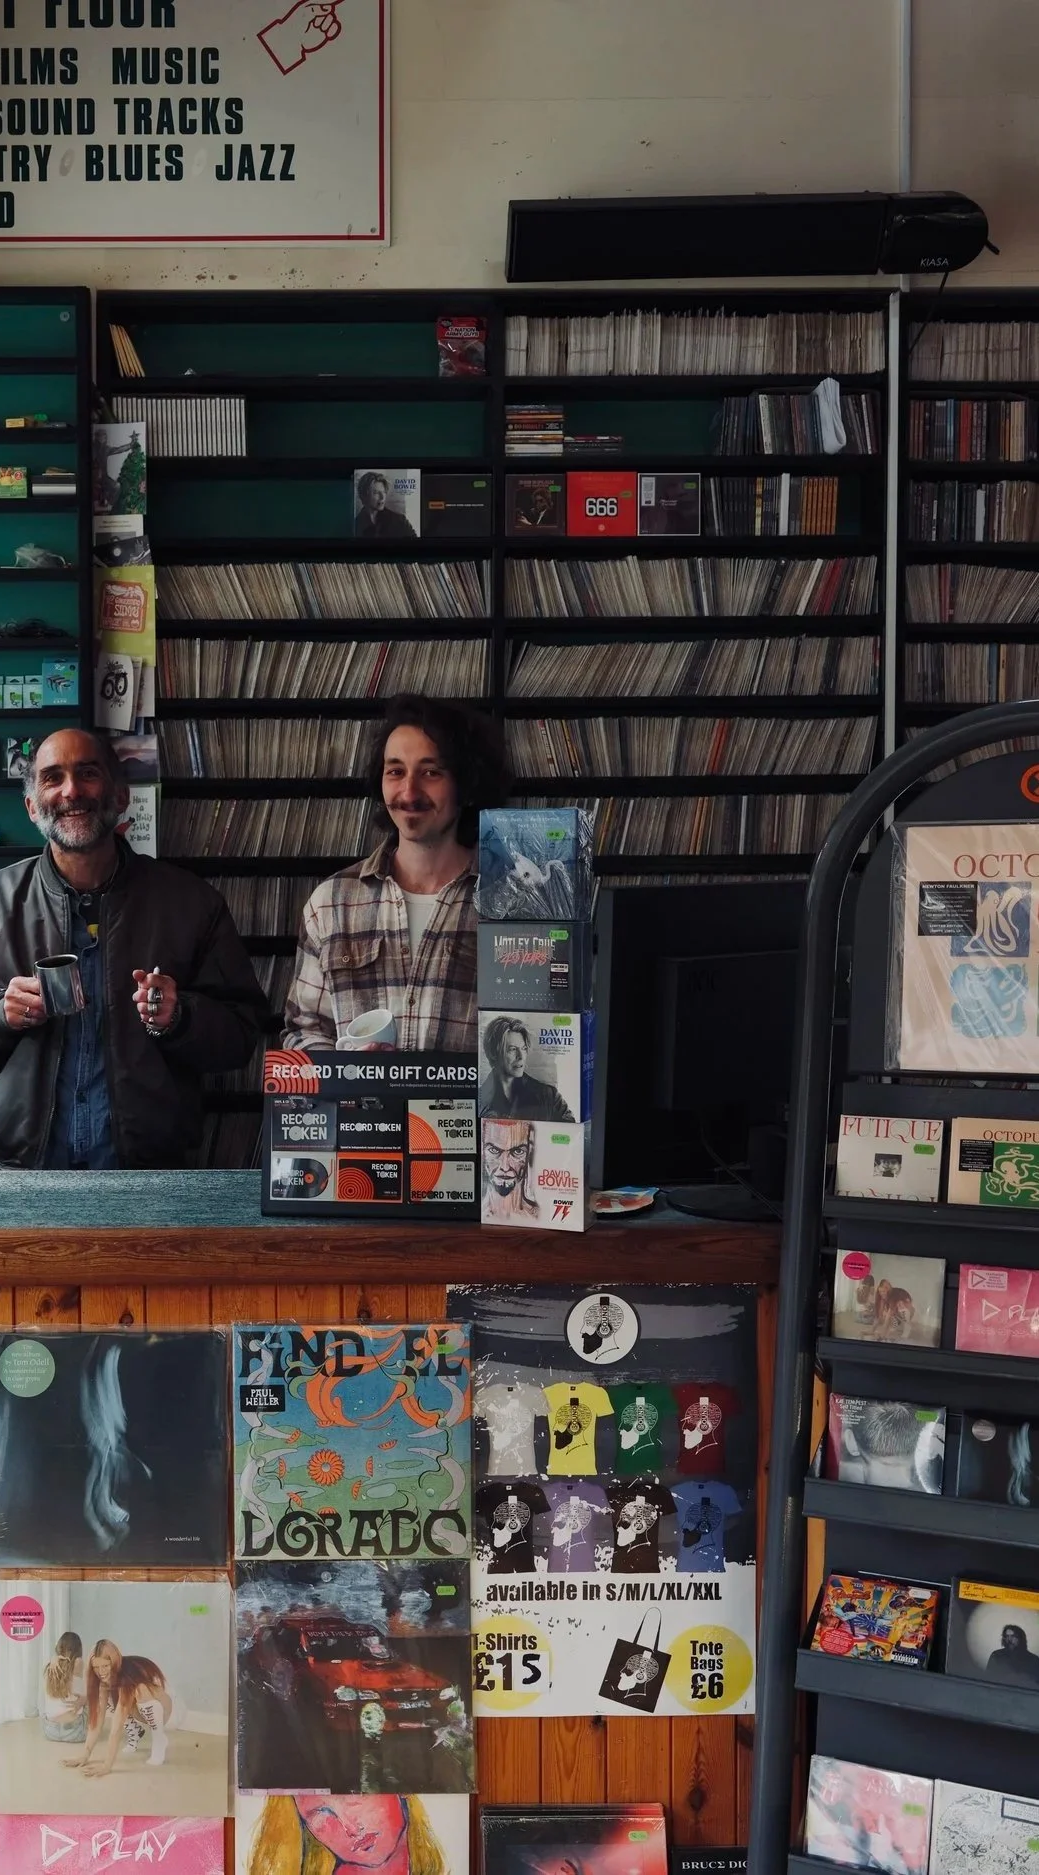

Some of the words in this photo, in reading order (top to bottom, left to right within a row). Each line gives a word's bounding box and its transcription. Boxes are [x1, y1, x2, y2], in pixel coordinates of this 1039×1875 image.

[112, 47, 219, 86] MUSIC
[114, 98, 243, 136] TRACKS
[85, 144, 184, 182] BLUES
[216, 144, 295, 181] JAZZ
[920, 257, 949, 267] KIASA
[585, 498, 618, 516] 666
[540, 1028, 573, 1038] DAVID
[538, 1037, 575, 1046] BOWIE
[272, 1063, 331, 1080] RECORD
[336, 1064, 385, 1081] TOKEN
[389, 1066, 422, 1081] GIFT
[426, 1066, 478, 1081] CARDS
[281, 1113, 328, 1126] RECORD
[340, 1122, 373, 1132] RECORD
[374, 1122, 402, 1132] TOKEN
[438, 1118, 473, 1128] RECORD
[282, 1126, 328, 1141] TOKEN
[444, 1129, 474, 1138] TOKEN
[842, 1116, 942, 1143] FUTIQUE
[371, 1163, 398, 1171] RECORD
[542, 1168, 571, 1179] DAVID
[376, 1171, 398, 1179] TOKEN
[538, 1175, 579, 1189] BOWIE
[412, 1190, 444, 1200] RECORD
[447, 1190, 474, 1200] TOKEN
[601, 1305, 609, 1332] SOUND
[239, 1330, 364, 1378] FIND
[406, 1329, 465, 1378] EL
[29, 1358, 49, 1366] Odell
[250, 1388, 274, 1397] PAUL
[245, 1397, 280, 1406] WELLER
[241, 1508, 467, 1558] DORADO
[486, 1579, 578, 1602] available
[582, 1580, 600, 1601] in
[606, 1581, 722, 1603] S/M/L/XL/XXL
[473, 1632, 538, 1651] T-Shirts
[690, 1641, 723, 1656] Tote
[690, 1655, 723, 1672] Bags
[473, 1652, 542, 1692] £15
[690, 1672, 724, 1699] £6
[91, 1828, 177, 1864] PLAY
